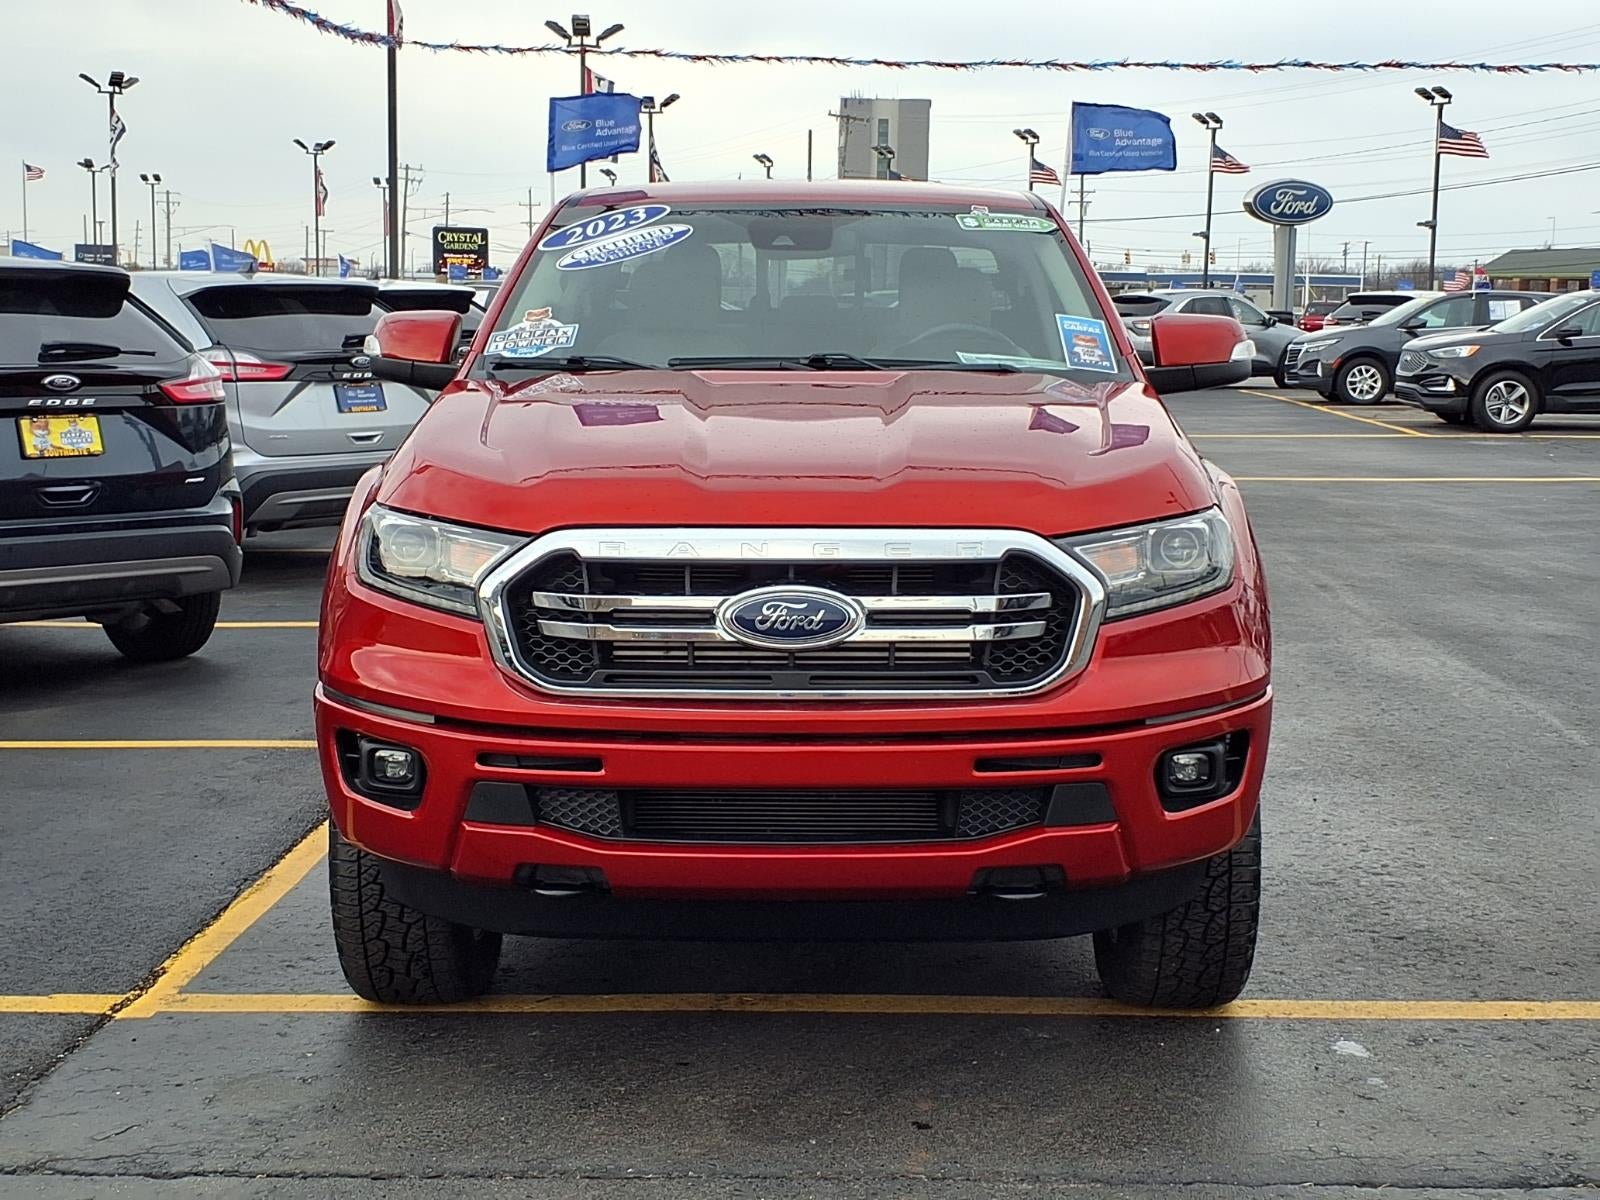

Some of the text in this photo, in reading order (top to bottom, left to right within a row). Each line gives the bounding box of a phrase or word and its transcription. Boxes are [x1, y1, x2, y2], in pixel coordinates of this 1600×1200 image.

[595, 119, 615, 128] Blue
[1113, 129, 1134, 138] Blue
[1114, 138, 1163, 147] Advantage
[1270, 188, 1318, 215] Ford
[566, 208, 647, 245] 2023
[437, 231, 486, 245] CRYSTAL
[571, 225, 675, 261] CERTIFIED
[443, 242, 479, 250] GARDENS
[494, 328, 570, 342] CARFAX
[505, 337, 569, 349] OWNER
[28, 398, 97, 407] EDGE
[598, 541, 984, 557] RANGER
[754, 601, 826, 631] Ford
